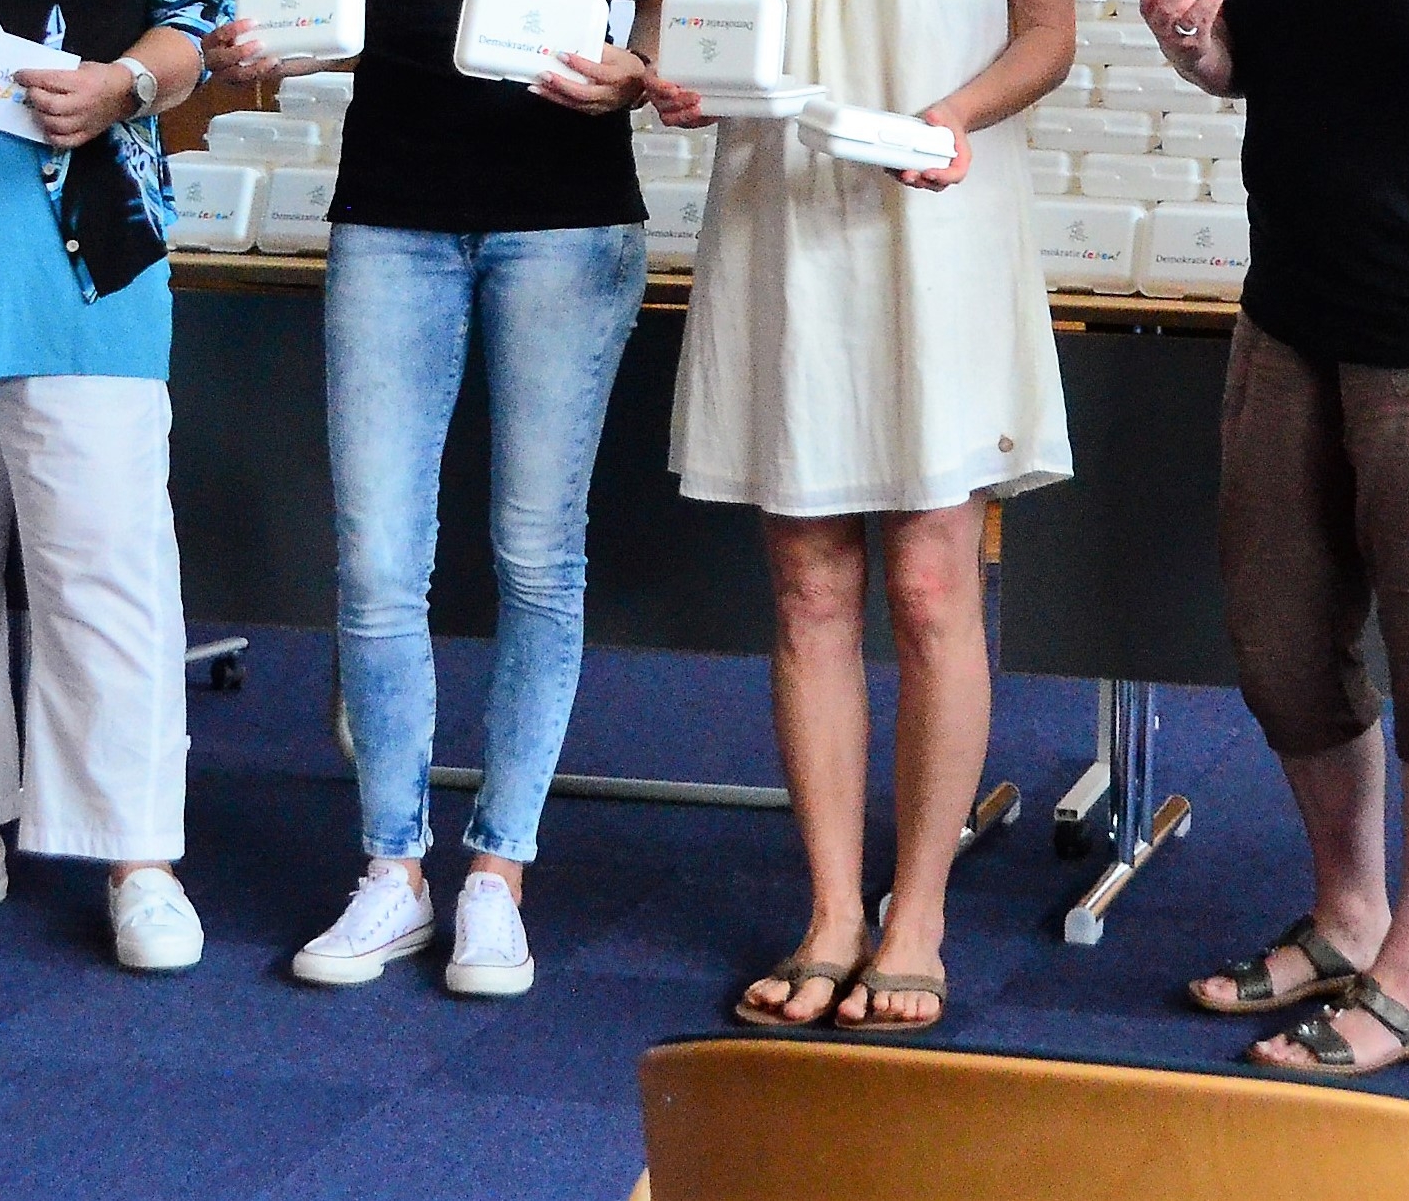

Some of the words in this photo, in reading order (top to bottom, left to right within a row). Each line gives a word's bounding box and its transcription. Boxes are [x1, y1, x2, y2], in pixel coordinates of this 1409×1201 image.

[706, 19, 754, 31] Demokratie
[478, 35, 535, 53] Demokratie
[272, 212, 320, 220] Demokratie
[1156, 253, 1208, 264] Demokratie
